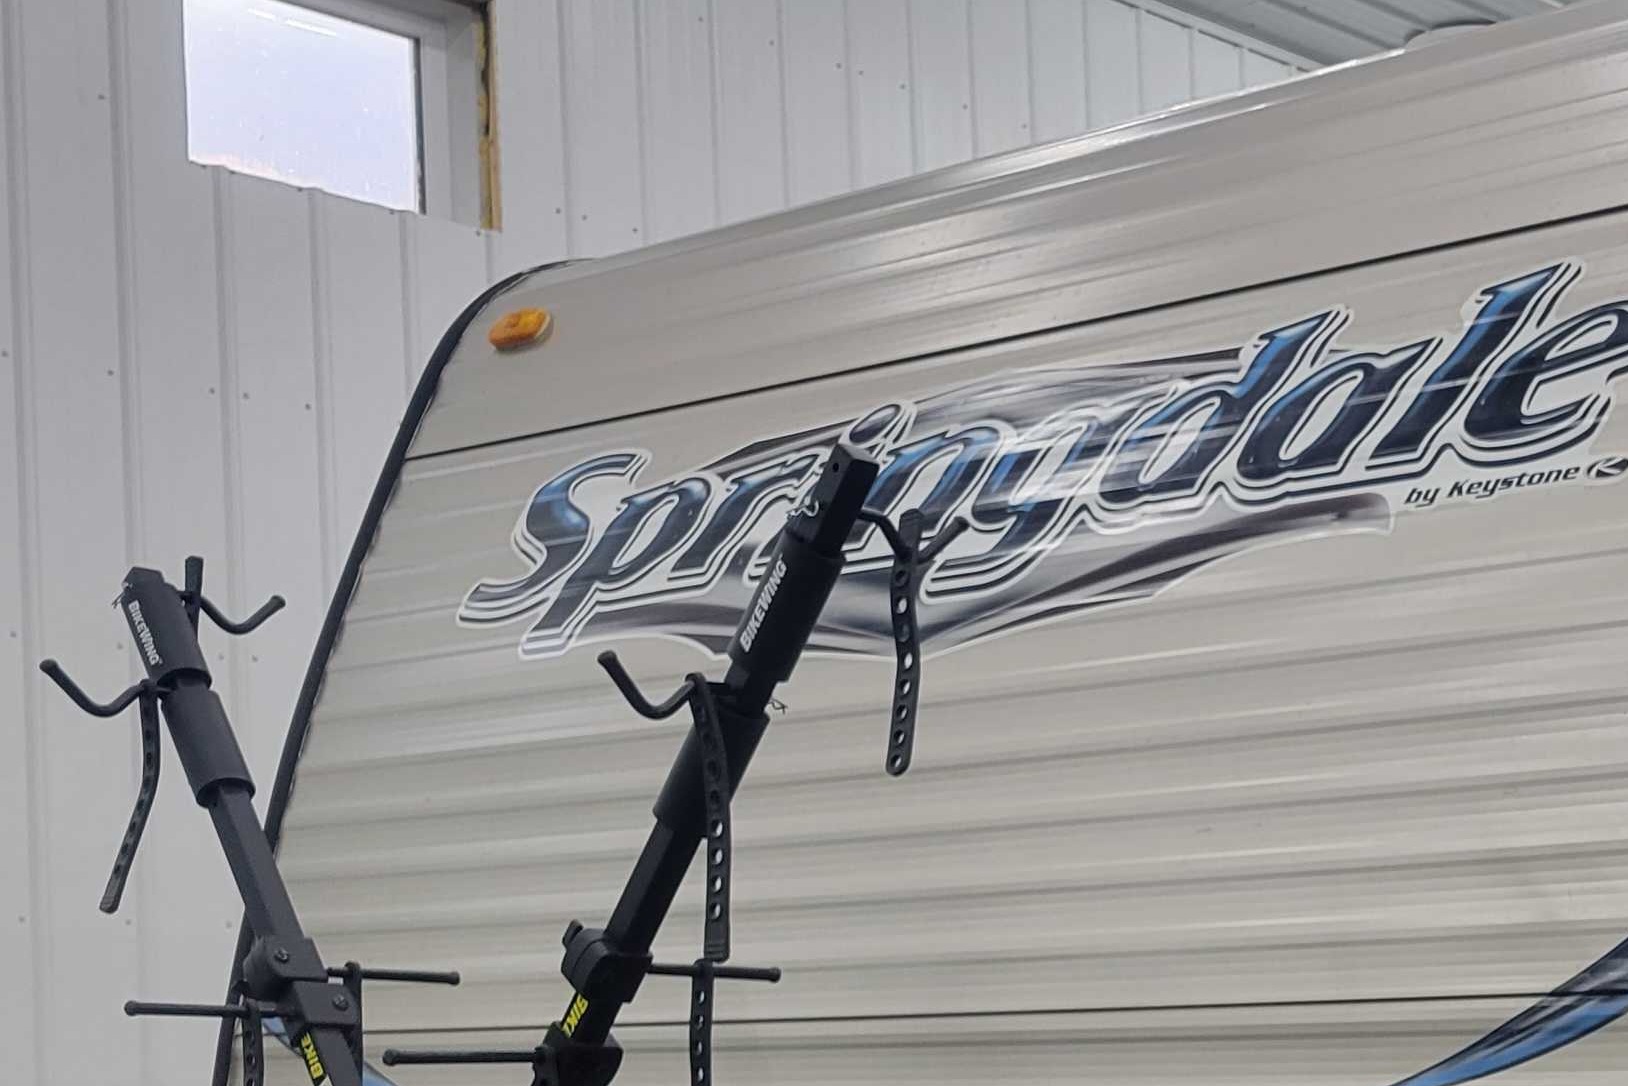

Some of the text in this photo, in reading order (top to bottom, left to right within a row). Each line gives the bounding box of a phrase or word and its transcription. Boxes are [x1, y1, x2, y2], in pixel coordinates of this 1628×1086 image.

[1404, 466, 1581, 508] by Keystone
[128, 599, 160, 666] BIKEWING
[741, 559, 787, 653] BIKEWING
